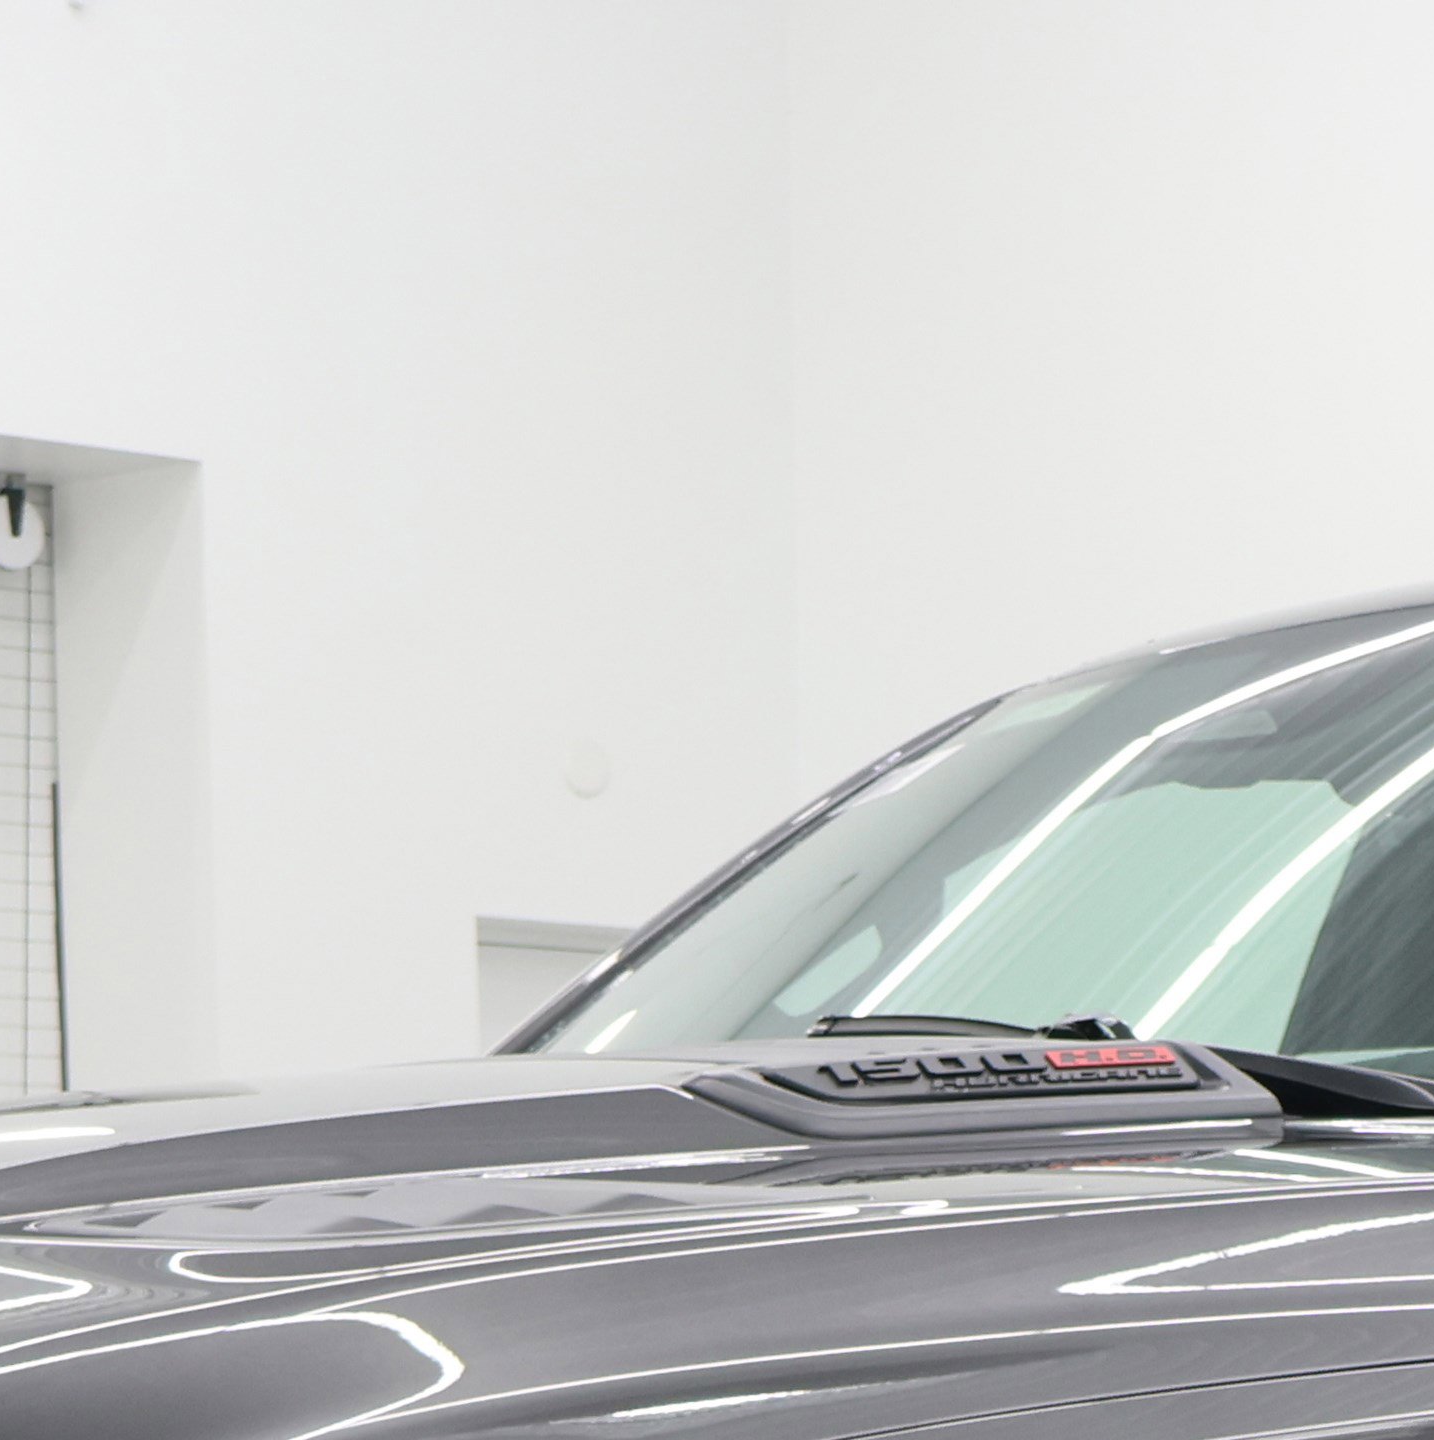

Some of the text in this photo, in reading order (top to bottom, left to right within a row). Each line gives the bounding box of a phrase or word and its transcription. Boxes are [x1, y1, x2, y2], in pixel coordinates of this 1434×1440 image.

[817, 1048, 1172, 1087] 1500 H.O.
[928, 1065, 1184, 1094] HURRICANE
